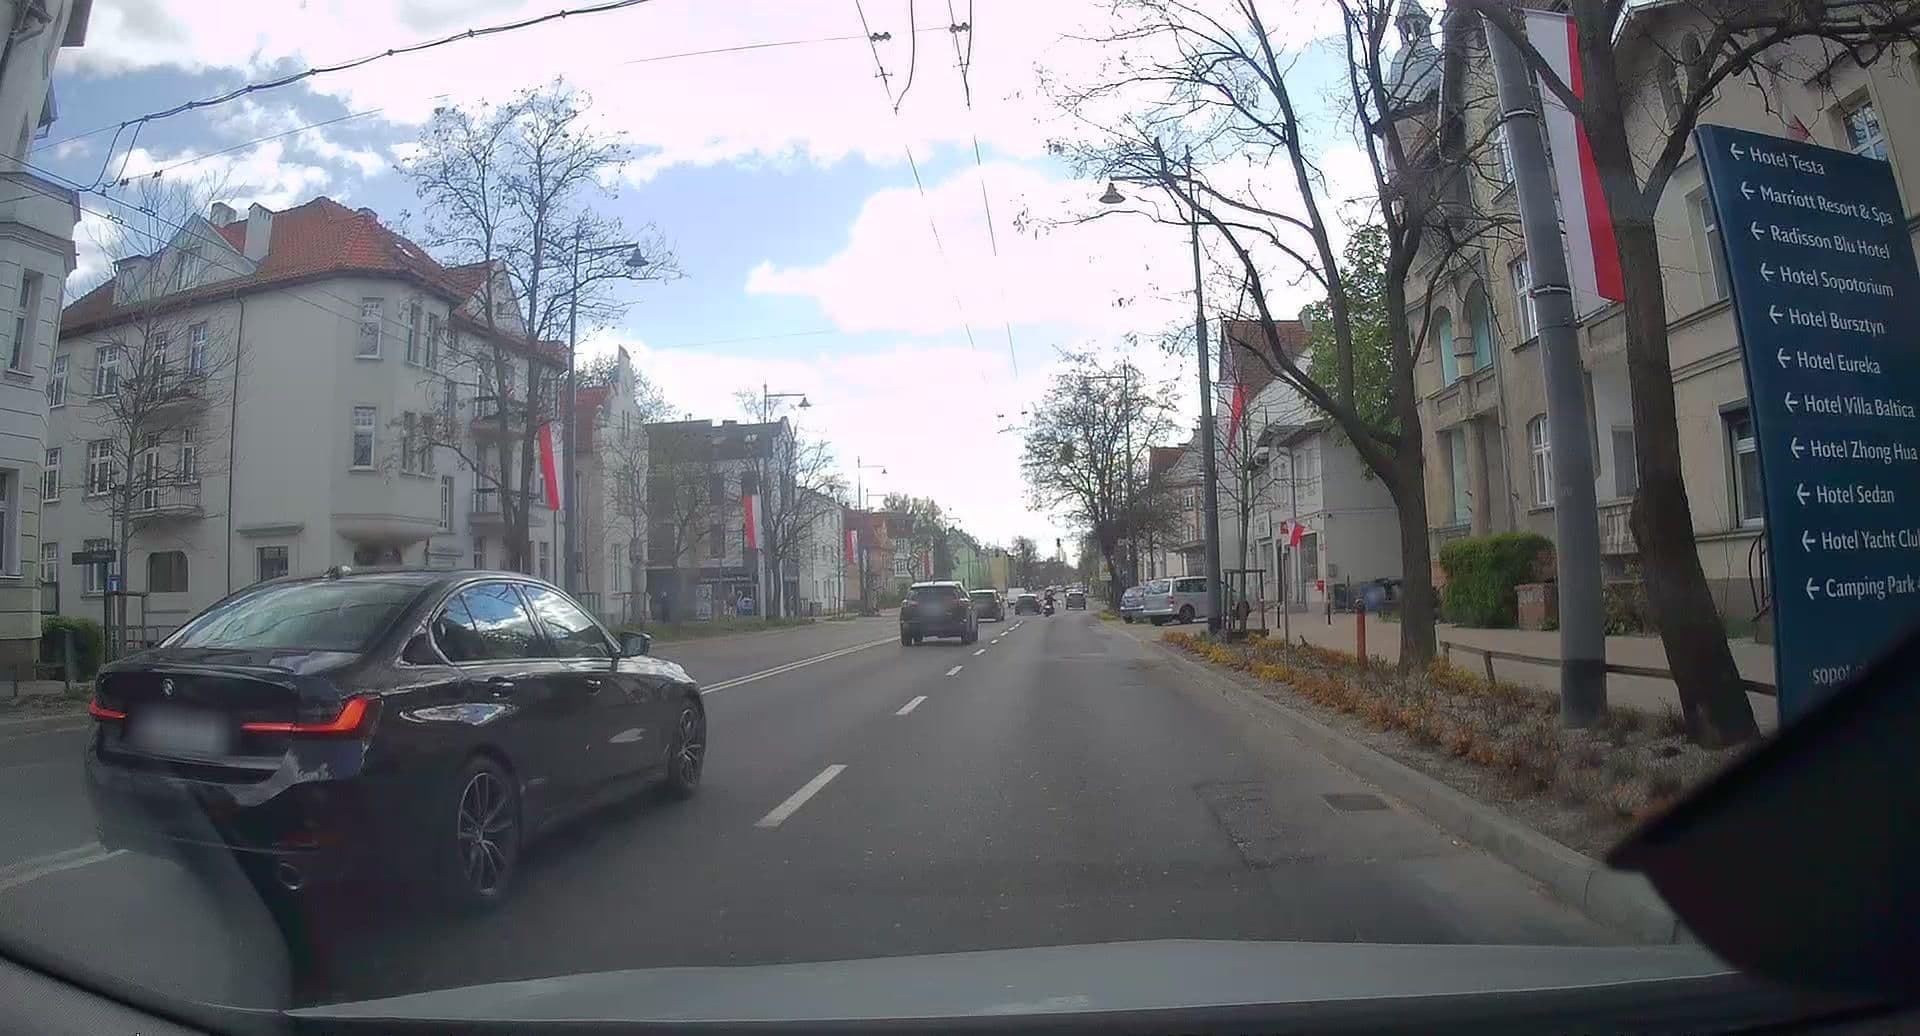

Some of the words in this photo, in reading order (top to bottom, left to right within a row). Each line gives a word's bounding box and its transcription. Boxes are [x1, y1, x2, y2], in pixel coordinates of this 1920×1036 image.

[1750, 146, 1788, 168] Hotel
[1791, 155, 1825, 176] Testa
[1760, 185, 1816, 209] Marriott
[1818, 195, 1857, 217] Resort
[1859, 204, 1871, 220] &
[1872, 207, 1894, 226] Spa
[1770, 225, 1832, 250] Radisson
[1834, 234, 1856, 254] Blu
[1857, 239, 1890, 259] Hotel
[1780, 267, 1818, 287] Hotel
[1822, 272, 1894, 298] Sopotorium
[1789, 308, 1828, 328] Hotel
[1830, 312, 1885, 337] Bursztyn
[1797, 352, 1835, 371] Hotel
[1839, 354, 1881, 374] Eureka
[1804, 394, 1842, 414] Hotel
[1843, 396, 1873, 416] Villa
[1875, 399, 1916, 418] Baltica
[1810, 439, 1848, 458] Hotel
[1850, 440, 1892, 465] Zhong
[1893, 442, 1918, 460] Hua
[1816, 485, 1854, 504] Hotel
[1857, 485, 1895, 504] Sedan
[1821, 530, 1859, 549] Hotel
[1861, 529, 1897, 549] Yacht
[1826, 576, 1886, 600] Camping
[1887, 573, 1915, 594] Park
